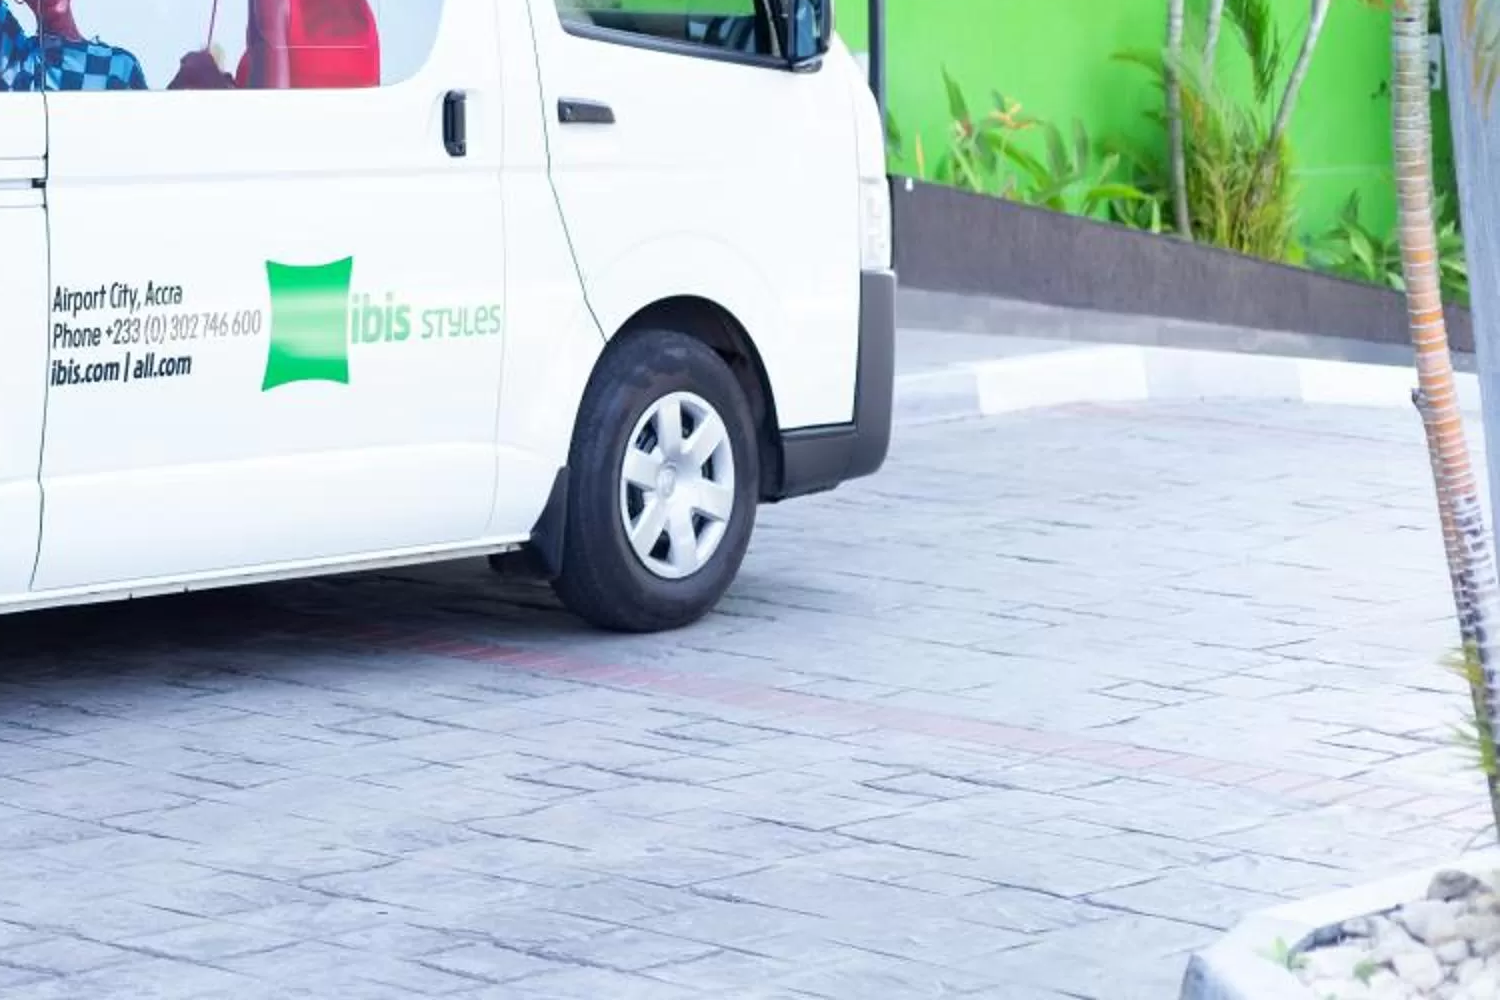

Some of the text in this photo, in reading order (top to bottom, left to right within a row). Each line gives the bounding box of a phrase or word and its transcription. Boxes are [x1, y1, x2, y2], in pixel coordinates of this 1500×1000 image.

[52, 280, 184, 318] Airport City, Accra
[351, 291, 411, 345] ibis
[53, 308, 262, 349] Phone +233 (0) 302 746 600
[50, 357, 120, 387] ibis.com
[133, 351, 192, 380] all.com
